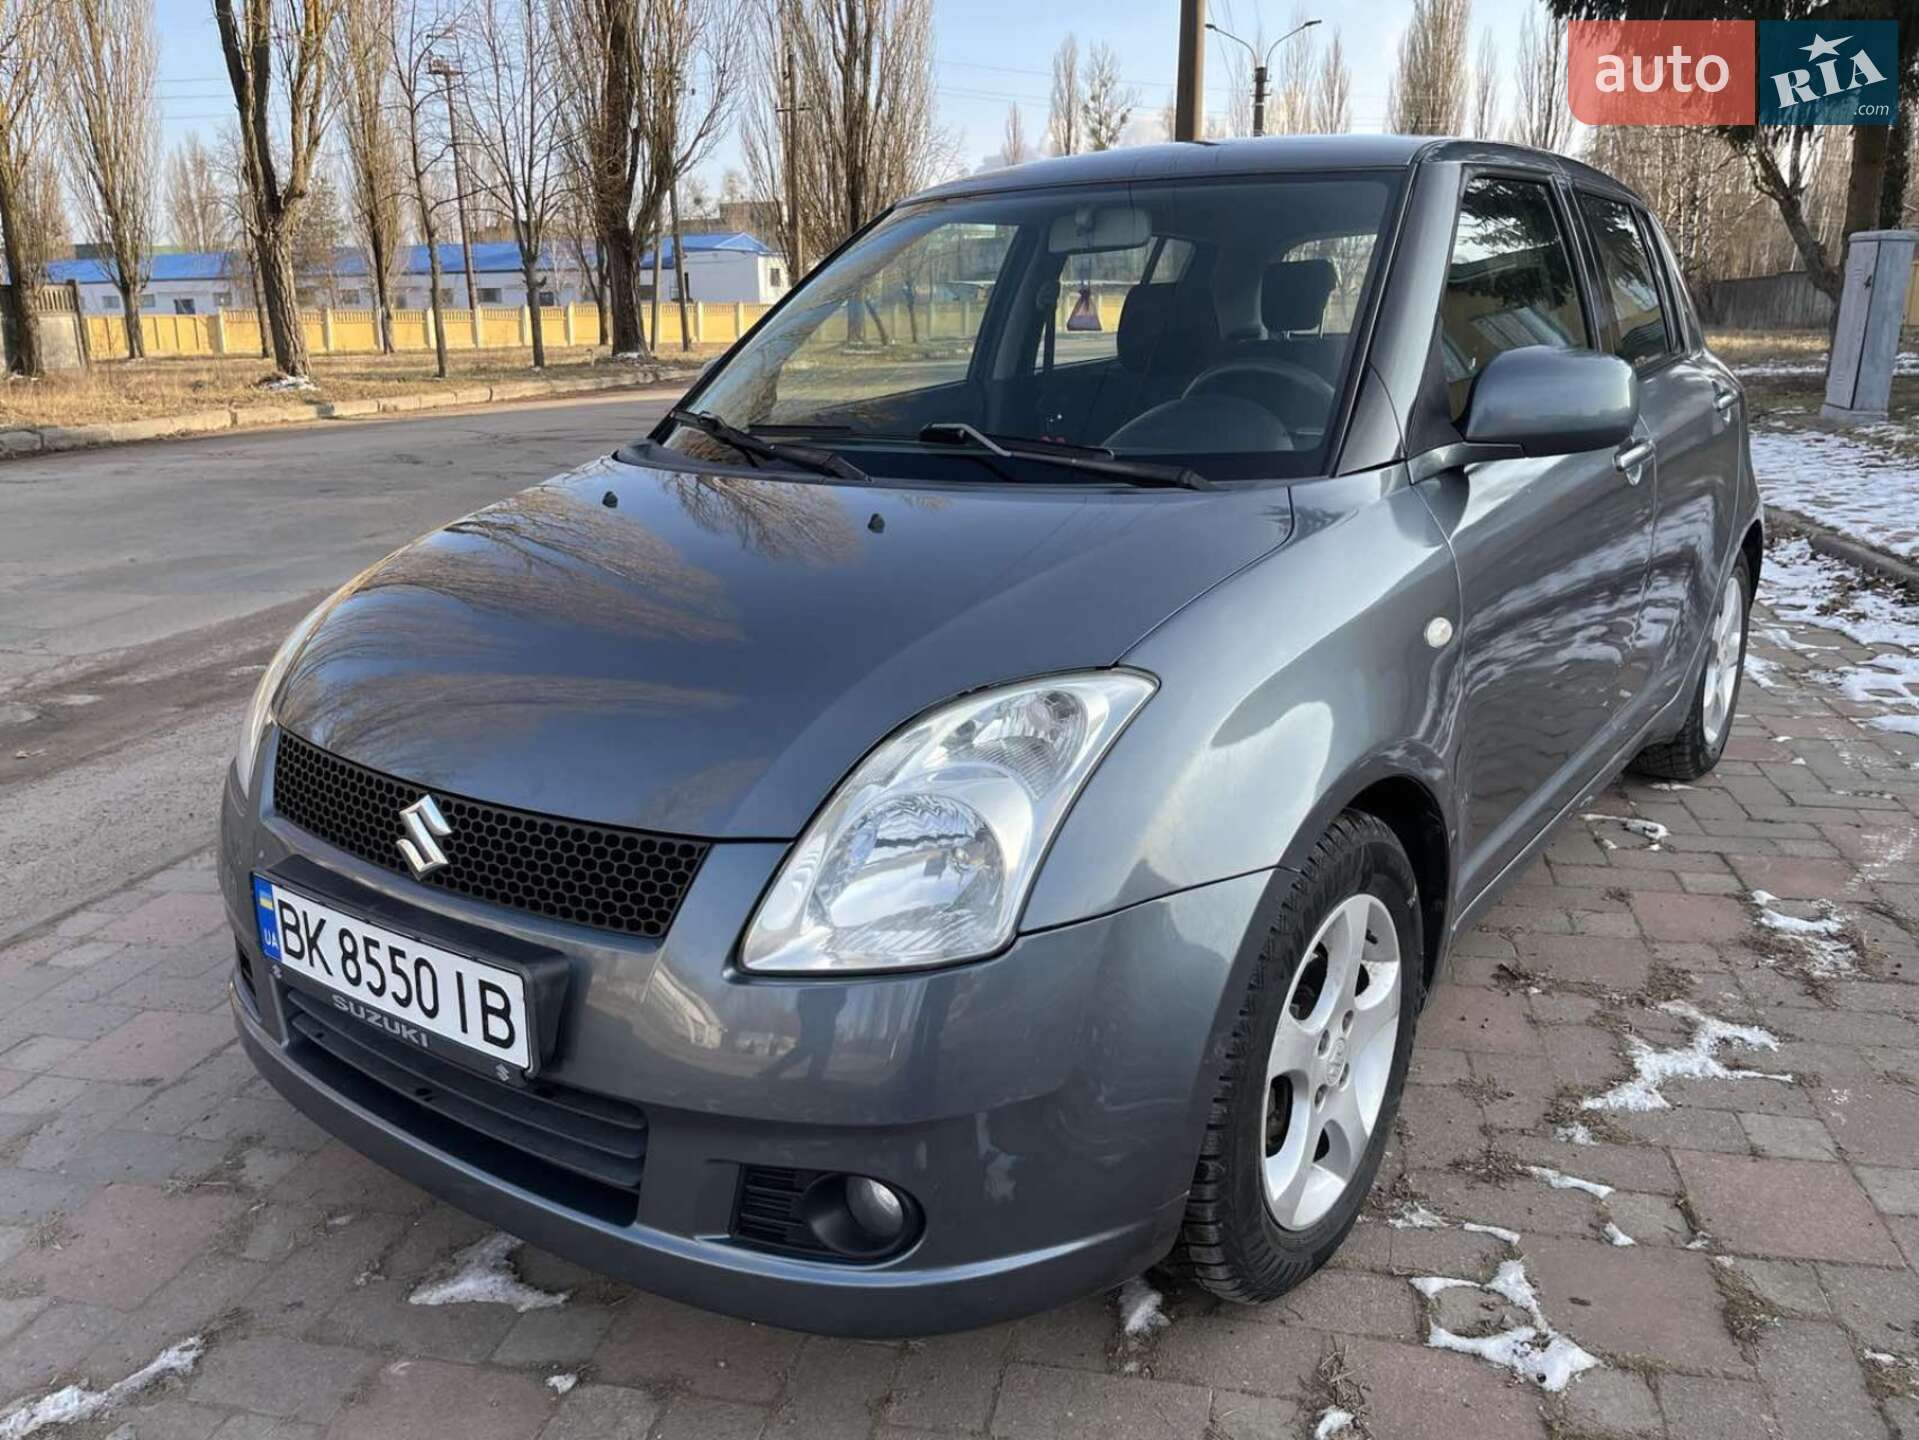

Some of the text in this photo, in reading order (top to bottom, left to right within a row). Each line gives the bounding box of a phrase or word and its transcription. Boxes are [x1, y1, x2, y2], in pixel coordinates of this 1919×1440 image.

[264, 930, 278, 949] UA
[278, 898, 515, 1050] BK 8550 IB
[332, 994, 430, 1048] SUZUKI
